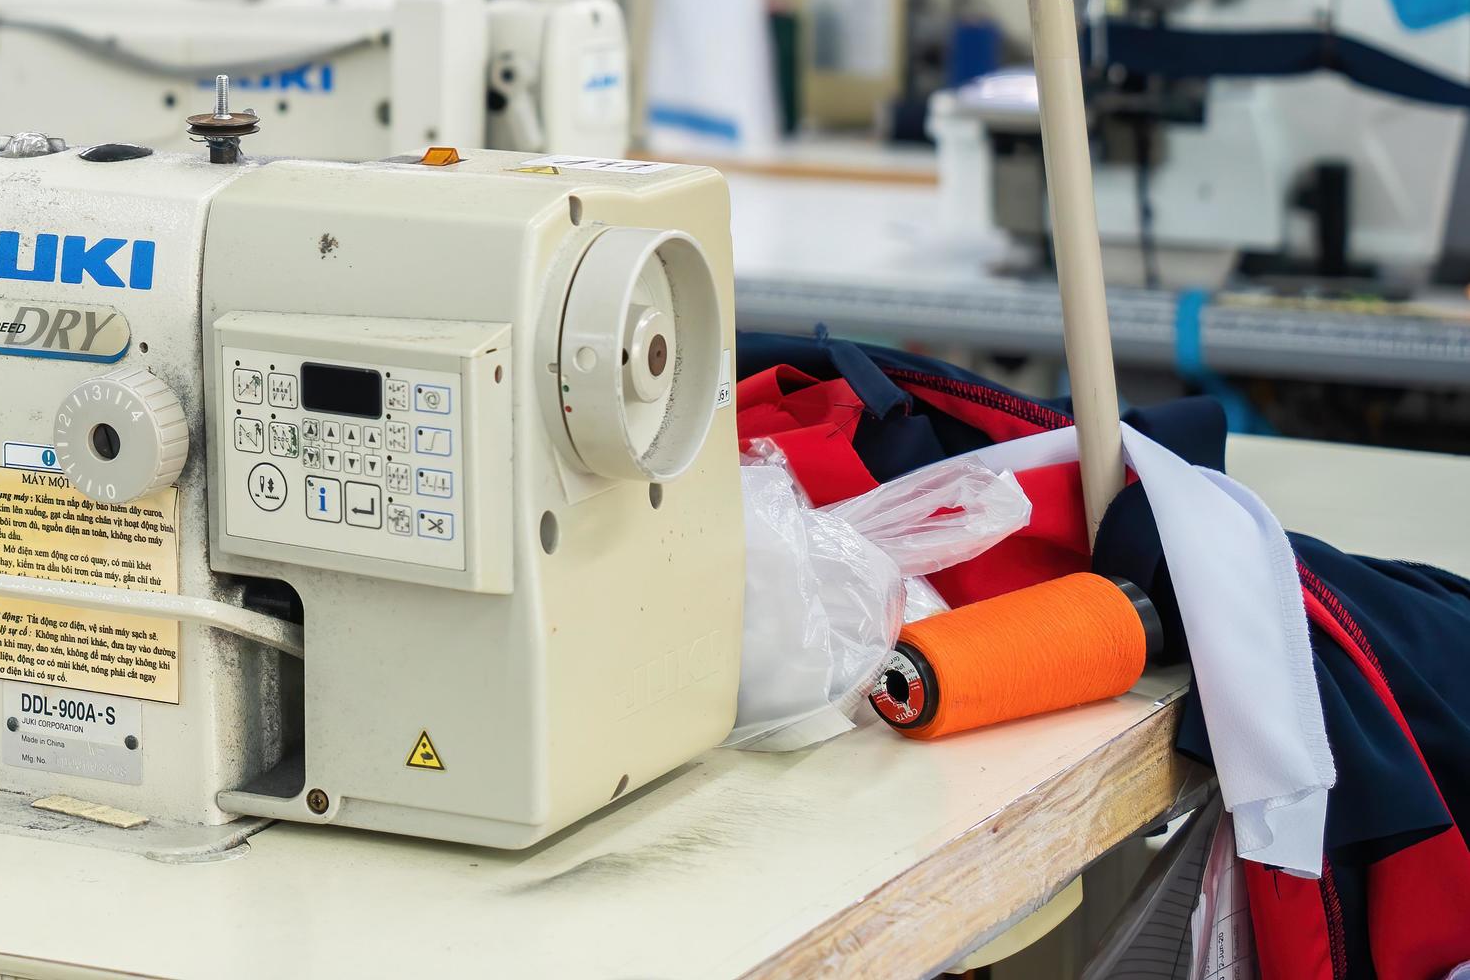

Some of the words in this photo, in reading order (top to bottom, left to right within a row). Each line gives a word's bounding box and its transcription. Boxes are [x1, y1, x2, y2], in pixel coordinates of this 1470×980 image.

[4, 307, 117, 351] DRY
[92, 385, 101, 400] 3
[59, 414, 71, 427] 2
[132, 412, 143, 421] 4
[22, 472, 46, 485] MÁY
[107, 484, 115, 499] 0
[99, 625, 113, 634] sinh
[4, 639, 15, 648] khi
[36, 644, 48, 652] dao
[159, 661, 170, 670] khi
[126, 643, 136, 653] tay
[24, 668, 34, 677] khi
[140, 673, 156, 683] ngay
[21, 693, 115, 725] DDL-900A-S
[38, 720, 84, 733] CORPORATION
[21, 735, 38, 744] Made
[47, 739, 65, 748] China
